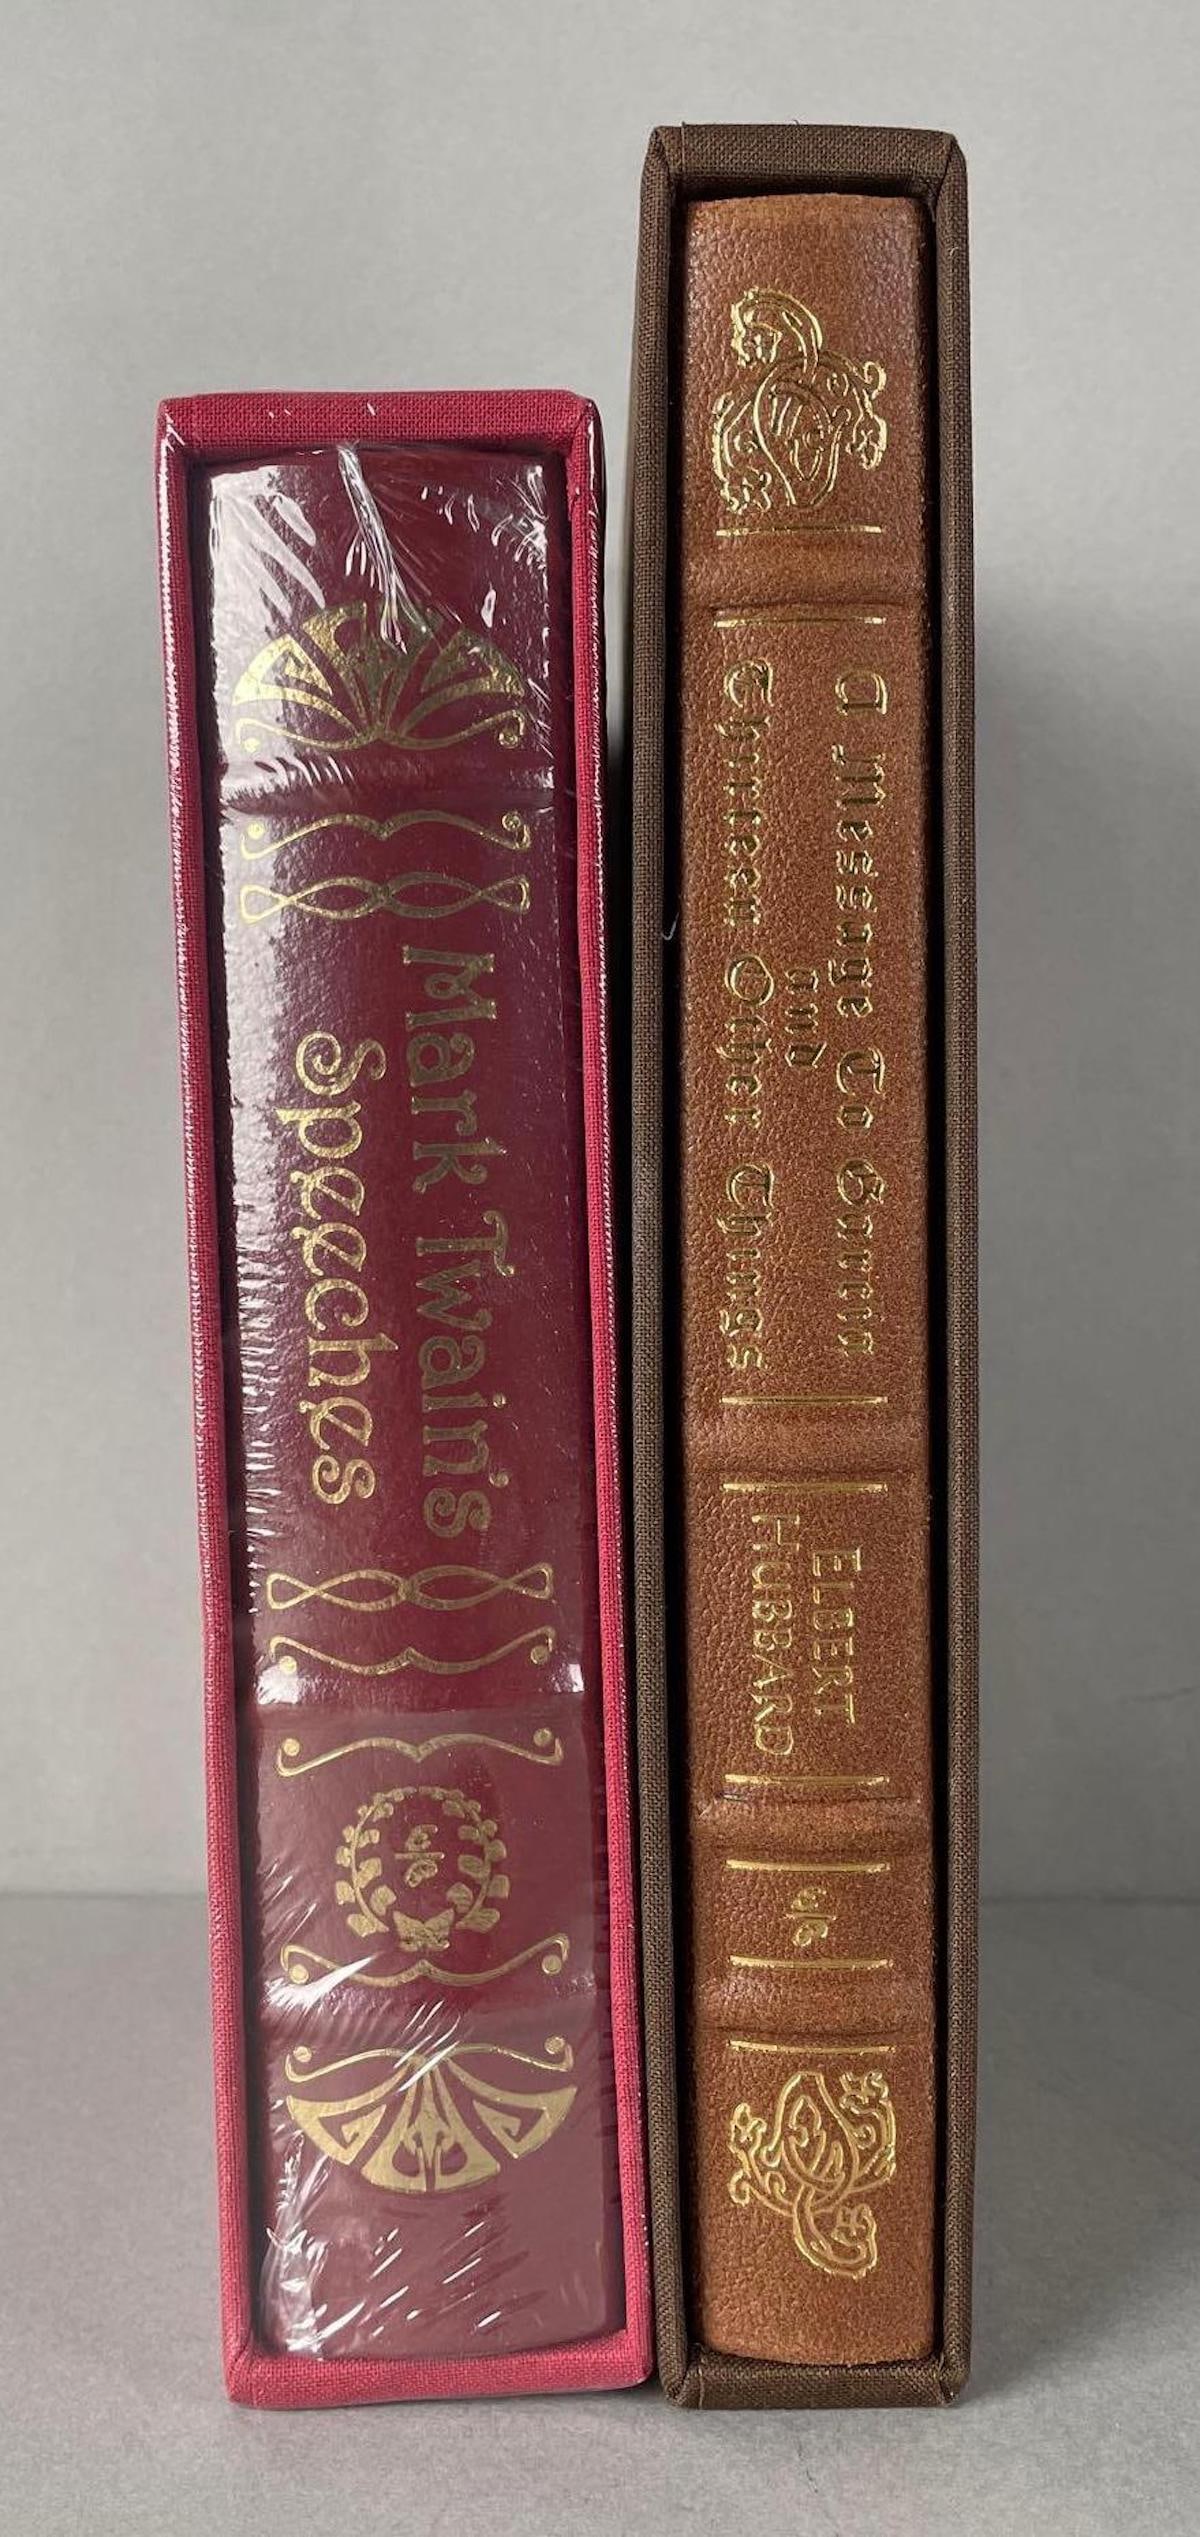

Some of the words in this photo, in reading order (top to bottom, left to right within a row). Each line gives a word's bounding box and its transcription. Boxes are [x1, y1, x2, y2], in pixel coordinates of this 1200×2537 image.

[714, 657, 775, 926] Thirteen
[834, 668, 888, 715] A
[829, 743, 886, 1016] Message
[402, 945, 506, 1195] Mark
[716, 954, 776, 1131] Other
[784, 967, 827, 1068] and
[836, 1046, 885, 1134] To
[275, 1030, 399, 1505] Speeches
[716, 1162, 775, 1370] Things
[836, 1159, 886, 1356] Garcia
[412, 1210, 515, 1540] Twain's
[751, 1513, 800, 1756] HUBBARD
[811, 1547, 862, 1724] ELBERT
